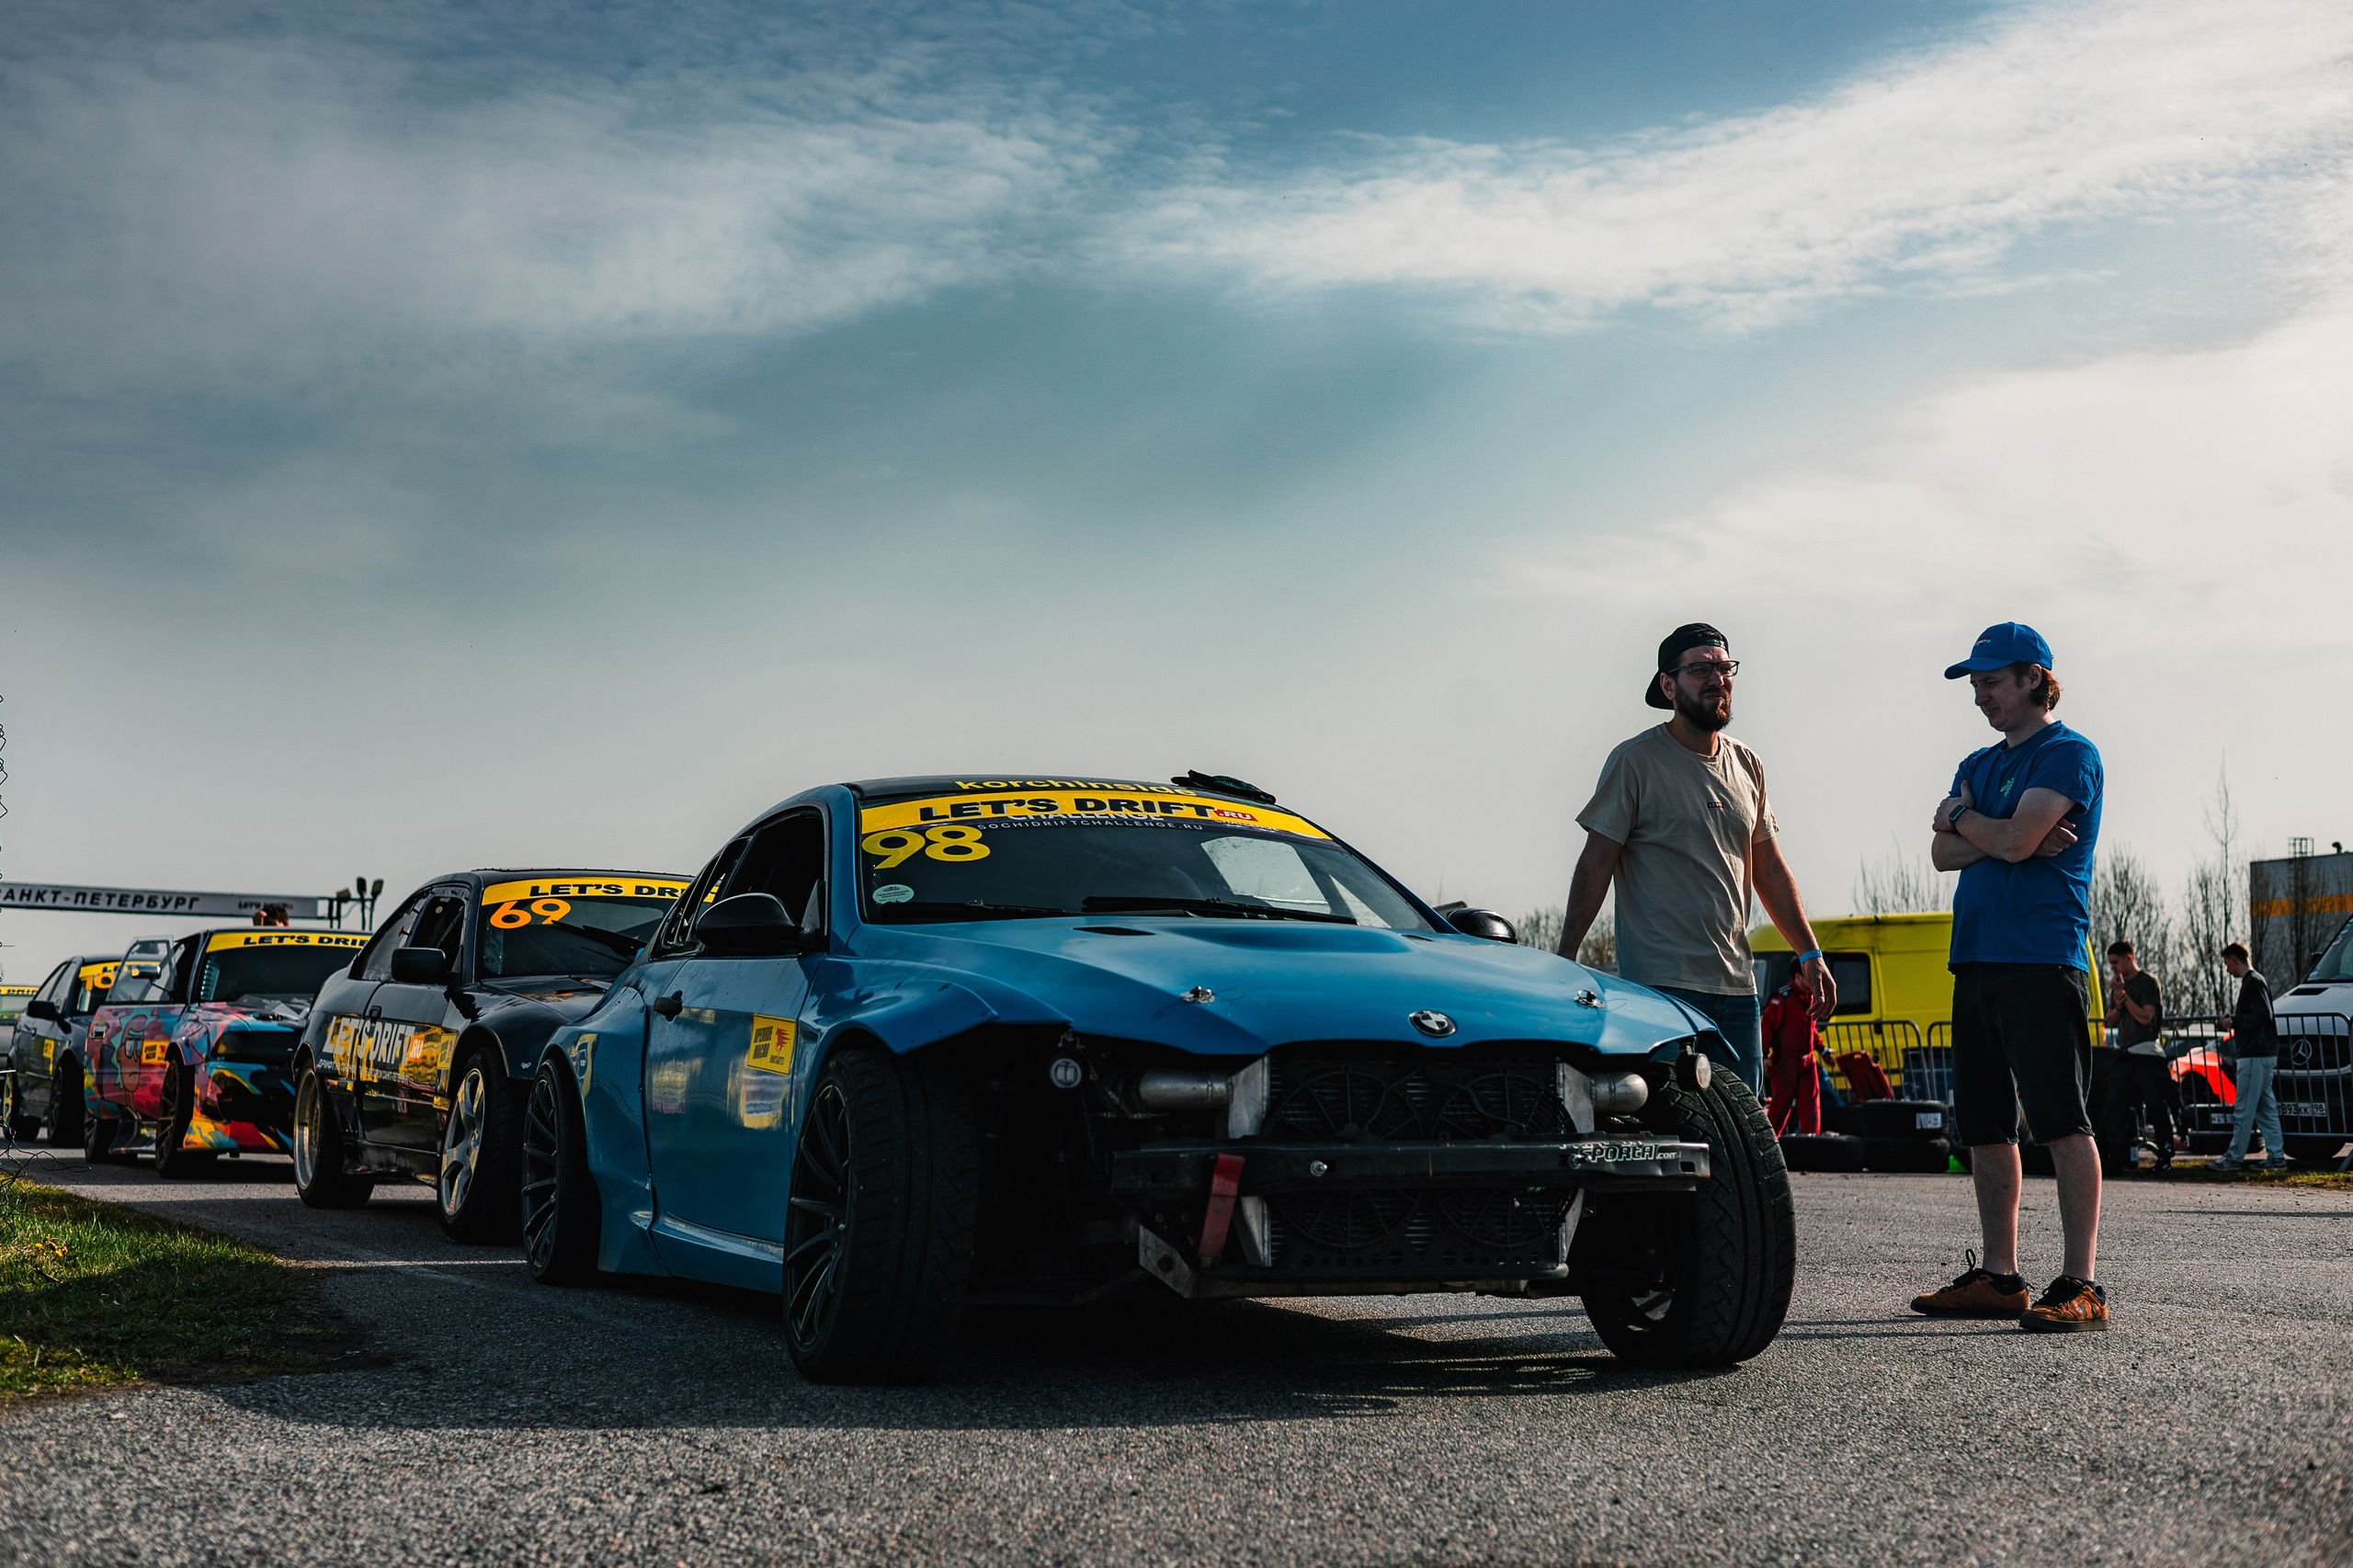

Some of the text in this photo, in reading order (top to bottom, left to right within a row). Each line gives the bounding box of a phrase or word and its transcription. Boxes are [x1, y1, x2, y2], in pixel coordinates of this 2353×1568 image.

[954, 779, 1198, 796] korchinside
[919, 798, 1060, 822] LET'S
[1074, 798, 1216, 818] DRIFT
[862, 824, 990, 869] 98
[0, 887, 200, 911] АНКТ-ПЕТЕРБУРГ
[529, 883, 624, 898] LET'S
[490, 898, 571, 929] 69
[243, 935, 369, 948] LET'S DRIF
[323, 1016, 370, 1060] LET'S
[369, 1021, 415, 1066] DRIFT
